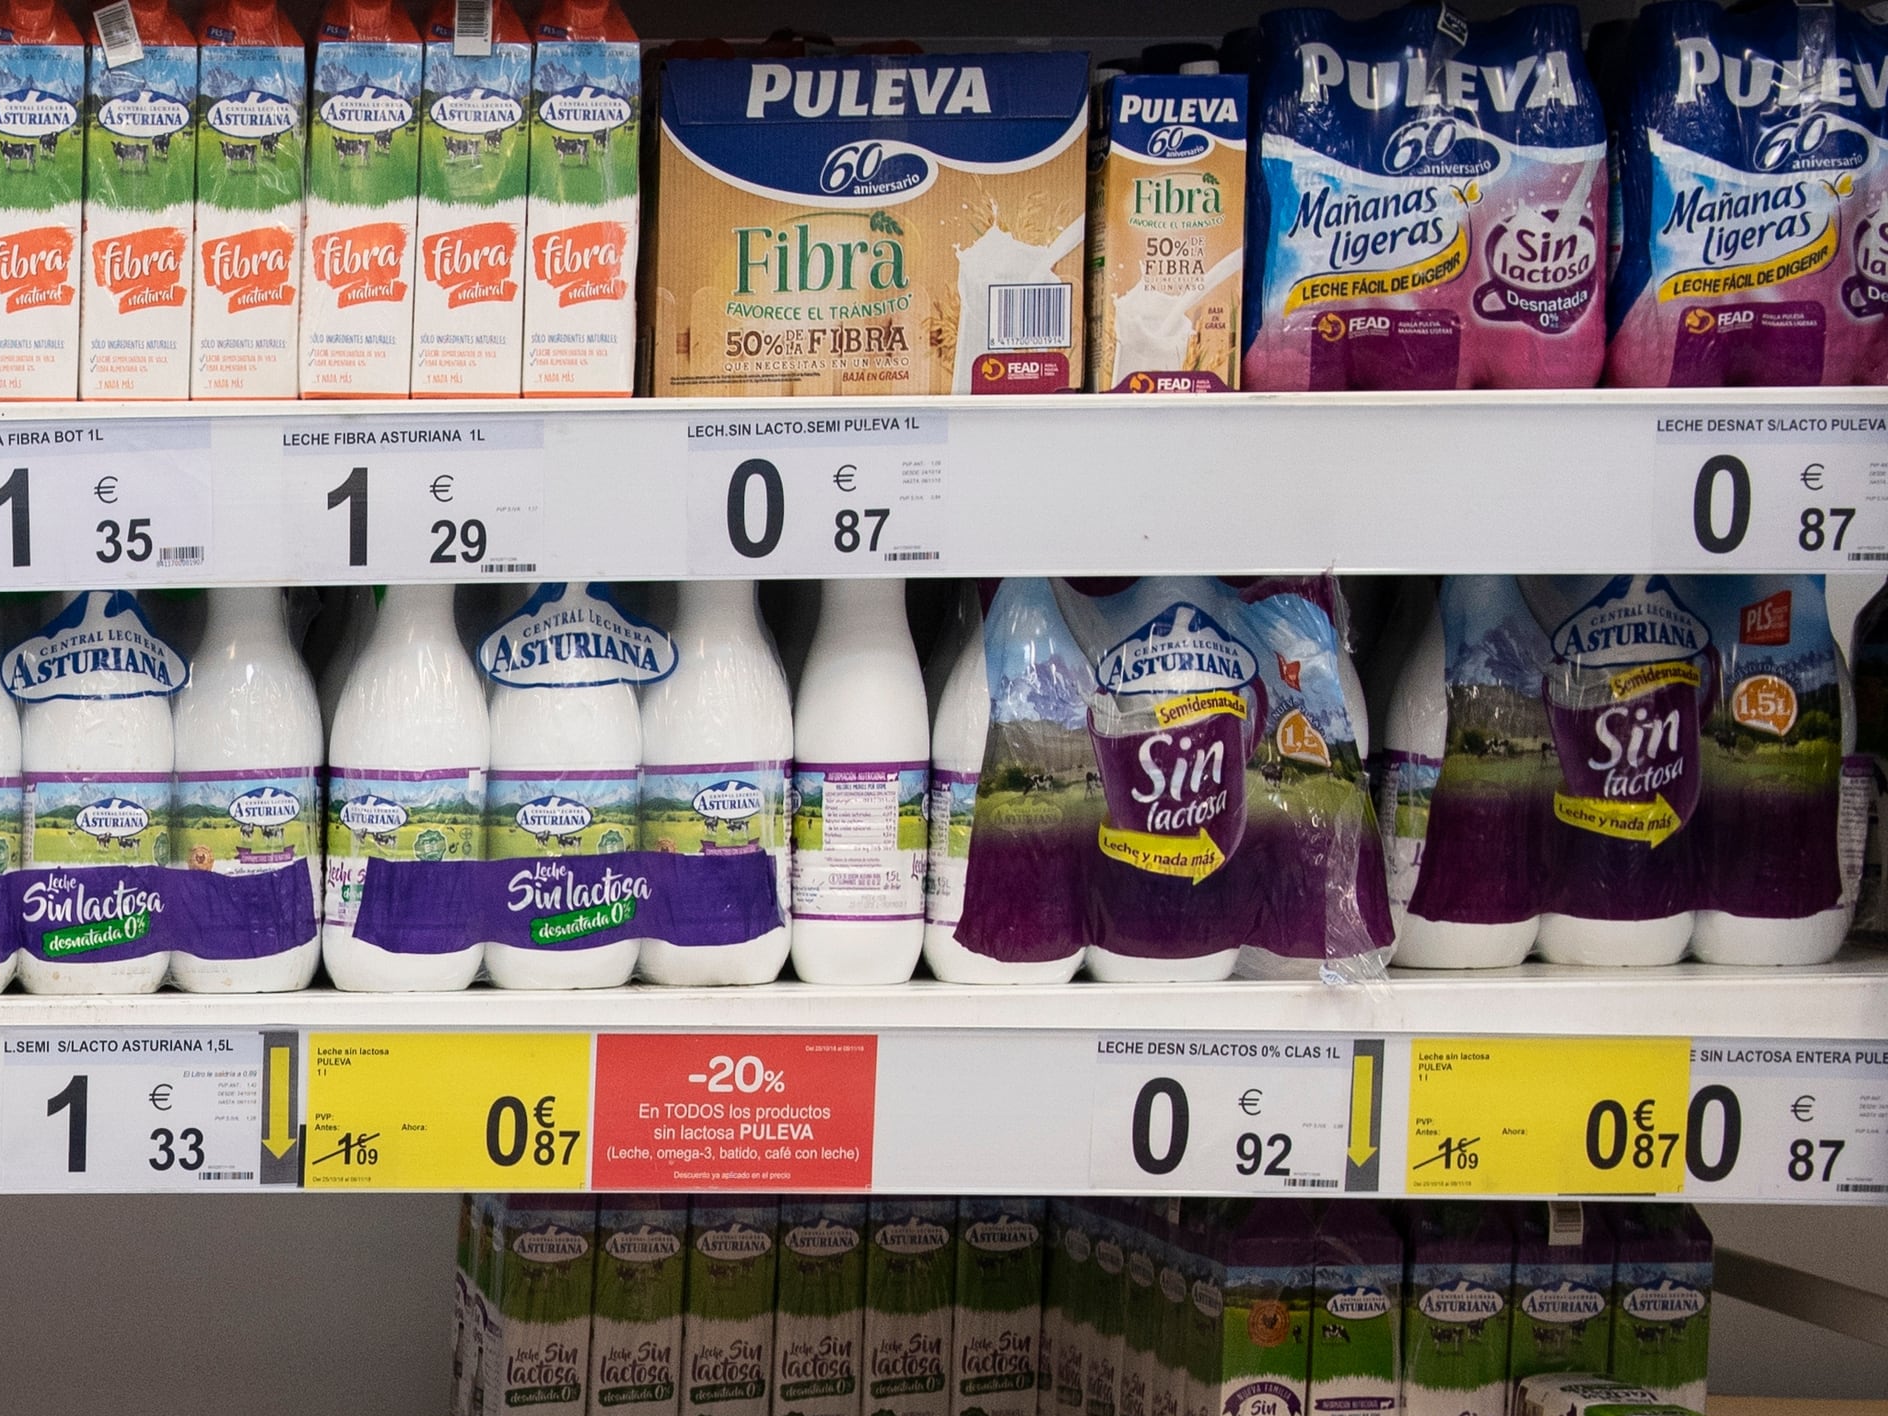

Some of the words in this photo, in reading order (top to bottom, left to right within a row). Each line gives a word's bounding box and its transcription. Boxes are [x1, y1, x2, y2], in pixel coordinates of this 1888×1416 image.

[746, 64, 992, 118] PULEVA
[1300, 42, 1578, 111] PULEVA
[1289, 186, 1438, 239] Mañanas
[733, 223, 909, 295] Fibra
[1329, 218, 1443, 269] ligeras
[1516, 228, 1578, 263] Sin
[1302, 280, 1348, 300] LECHE
[1352, 275, 1387, 294] FÁCIL
[1391, 273, 1408, 291] DE
[1412, 254, 1460, 286] DIGERIR
[1500, 247, 1590, 282] lactosa
[14, 289, 62, 304] natural
[1507, 288, 1588, 313] Desnatada
[726, 331, 784, 356] 50%
[809, 327, 909, 352] FIBRA
[283, 434, 331, 447] LECHE
[334, 433, 376, 446] FIBRA
[379, 431, 462, 444] ASTURIANA
[469, 430, 485, 443] 1L
[687, 423, 752, 438] LECH.SIN
[755, 419, 841, 436] LACTO.SEMI
[844, 417, 900, 433] PULEVA
[904, 417, 920, 430] 1L
[1657, 420, 1703, 432] LECHE
[1707, 419, 1764, 431] DESNAT
[1767, 419, 1827, 431] S/LACTO
[1831, 418, 1887, 431] PULEVA
[430, 520, 487, 564] 29
[1799, 508, 1856, 551] 87
[4, 1041, 52, 1054] L.SEMI
[57, 1041, 119, 1054] S/LACTO
[122, 1040, 203, 1054] ASTURIANA
[206, 1039, 233, 1054] 1,5L
[689, 1055, 784, 1094] -20%
[639, 1103, 659, 1119] En
[664, 1103, 724, 1119] TODOS
[728, 1102, 750, 1119] los
[755, 1104, 831, 1123] productos
[654, 1126, 675, 1140] sin
[680, 1125, 735, 1140] lactosa
[740, 1124, 813, 1141] PULEVA
[606, 1146, 652, 1162] (Leche,
[656, 1147, 715, 1162] omega-3,
[719, 1146, 760, 1161] batido,
[763, 1145, 791, 1161] café
[795, 1149, 816, 1160] con
[820, 1145, 859, 1161] leche)
